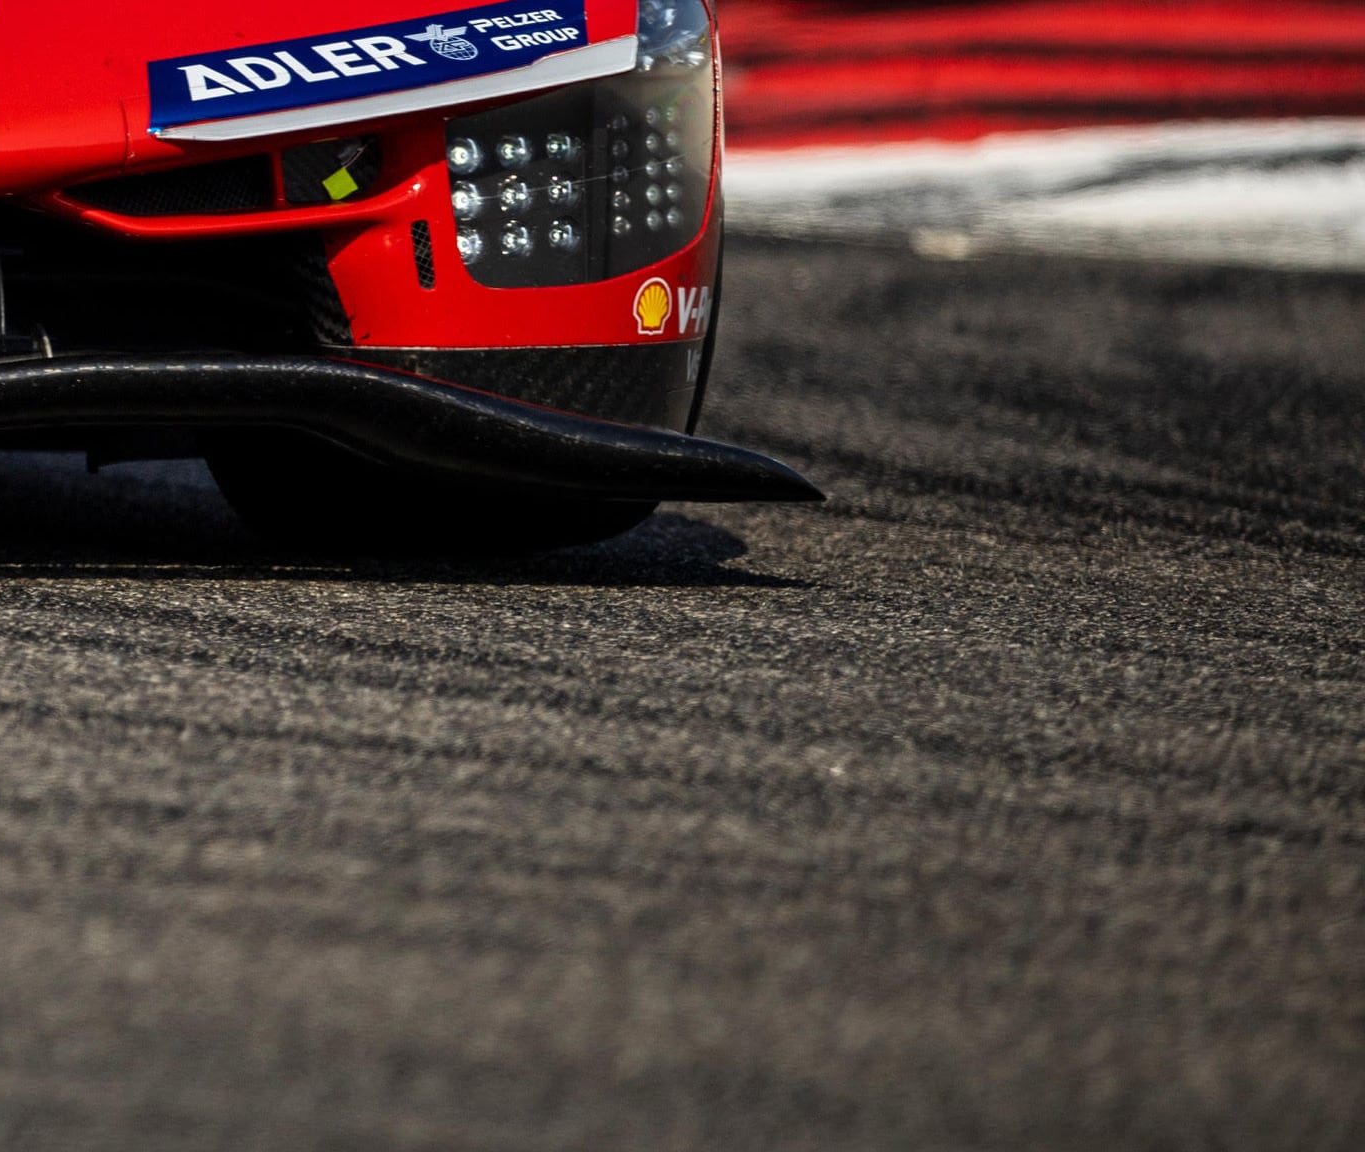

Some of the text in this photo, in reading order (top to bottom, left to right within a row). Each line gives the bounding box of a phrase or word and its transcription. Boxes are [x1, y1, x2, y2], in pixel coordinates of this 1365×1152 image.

[176, 8, 564, 102] ADLER PELZER
[490, 26, 580, 52] GROUP
